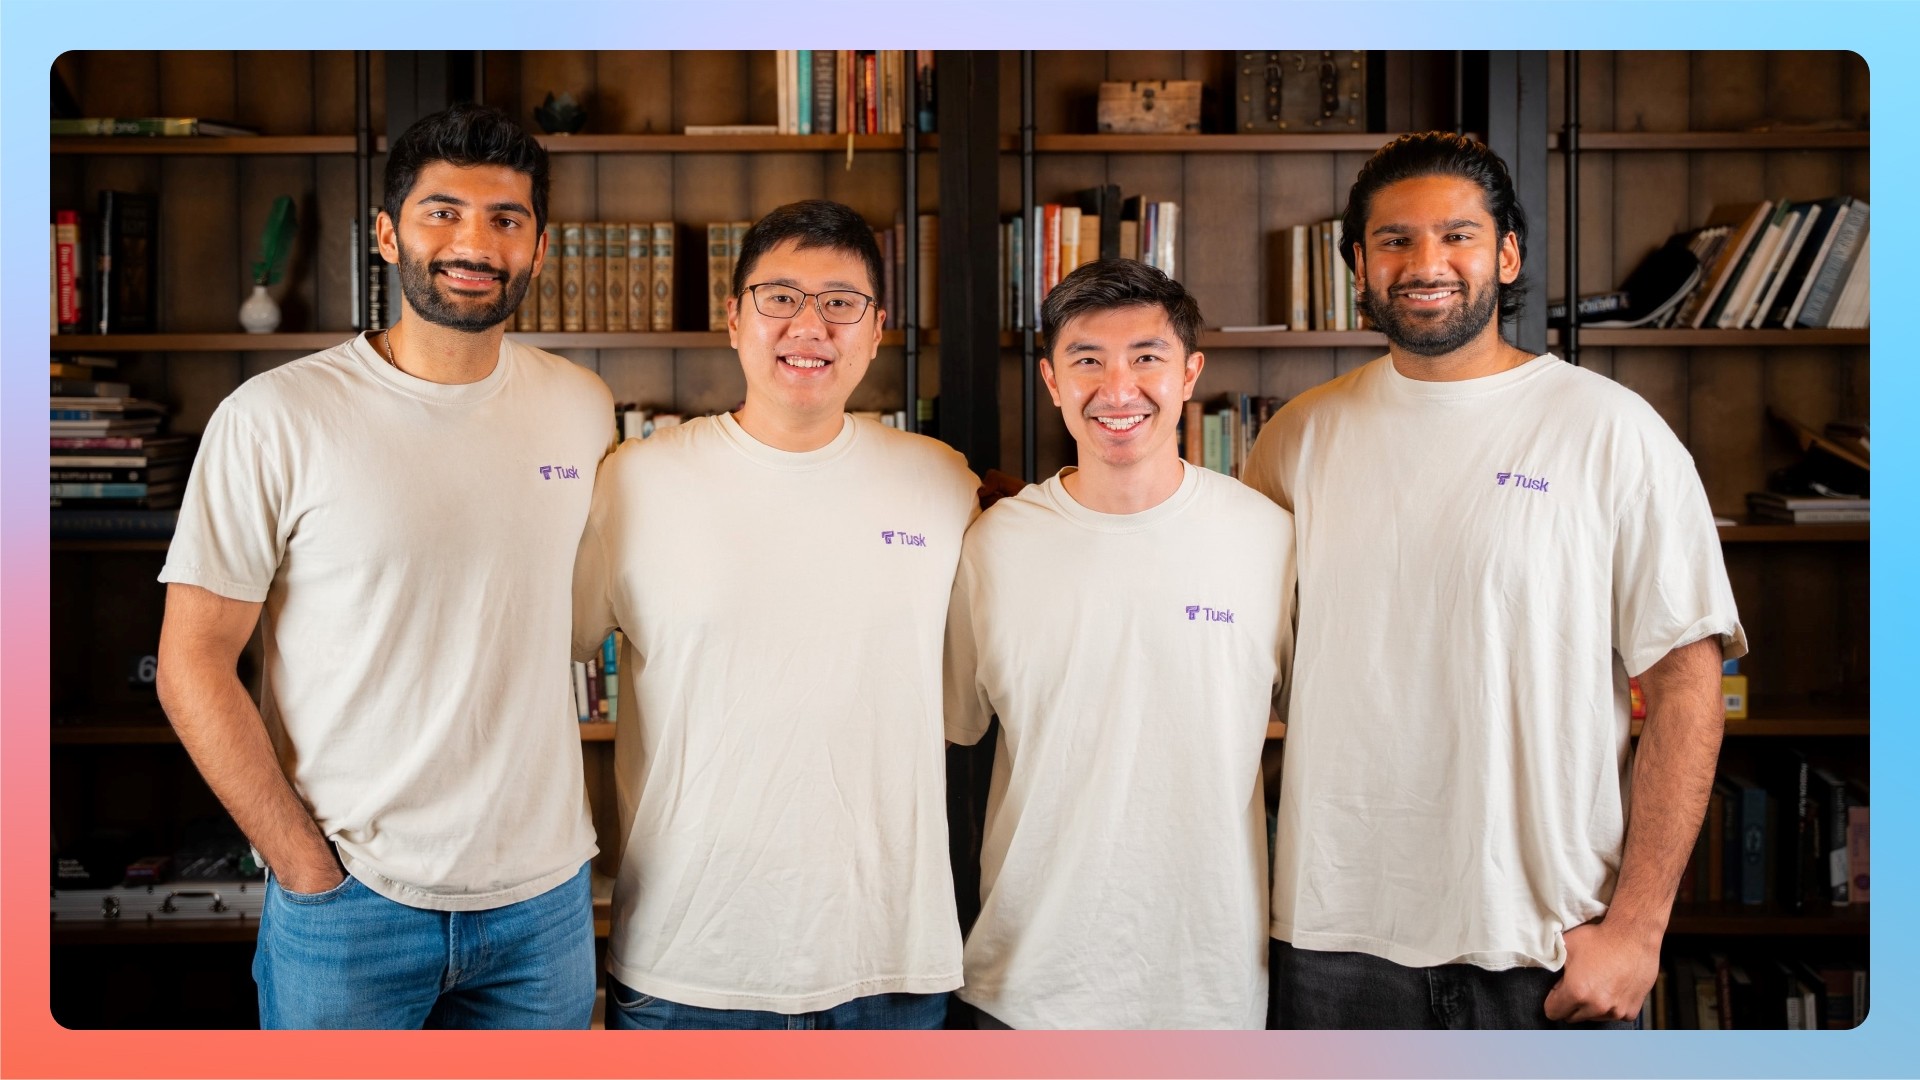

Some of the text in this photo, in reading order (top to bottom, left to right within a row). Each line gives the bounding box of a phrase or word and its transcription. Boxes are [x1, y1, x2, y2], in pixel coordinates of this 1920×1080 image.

[554, 465, 580, 479] Tusk
[1513, 474, 1549, 492] Tusk
[897, 531, 926, 547] Tusk
[1202, 607, 1234, 623] Tusk
